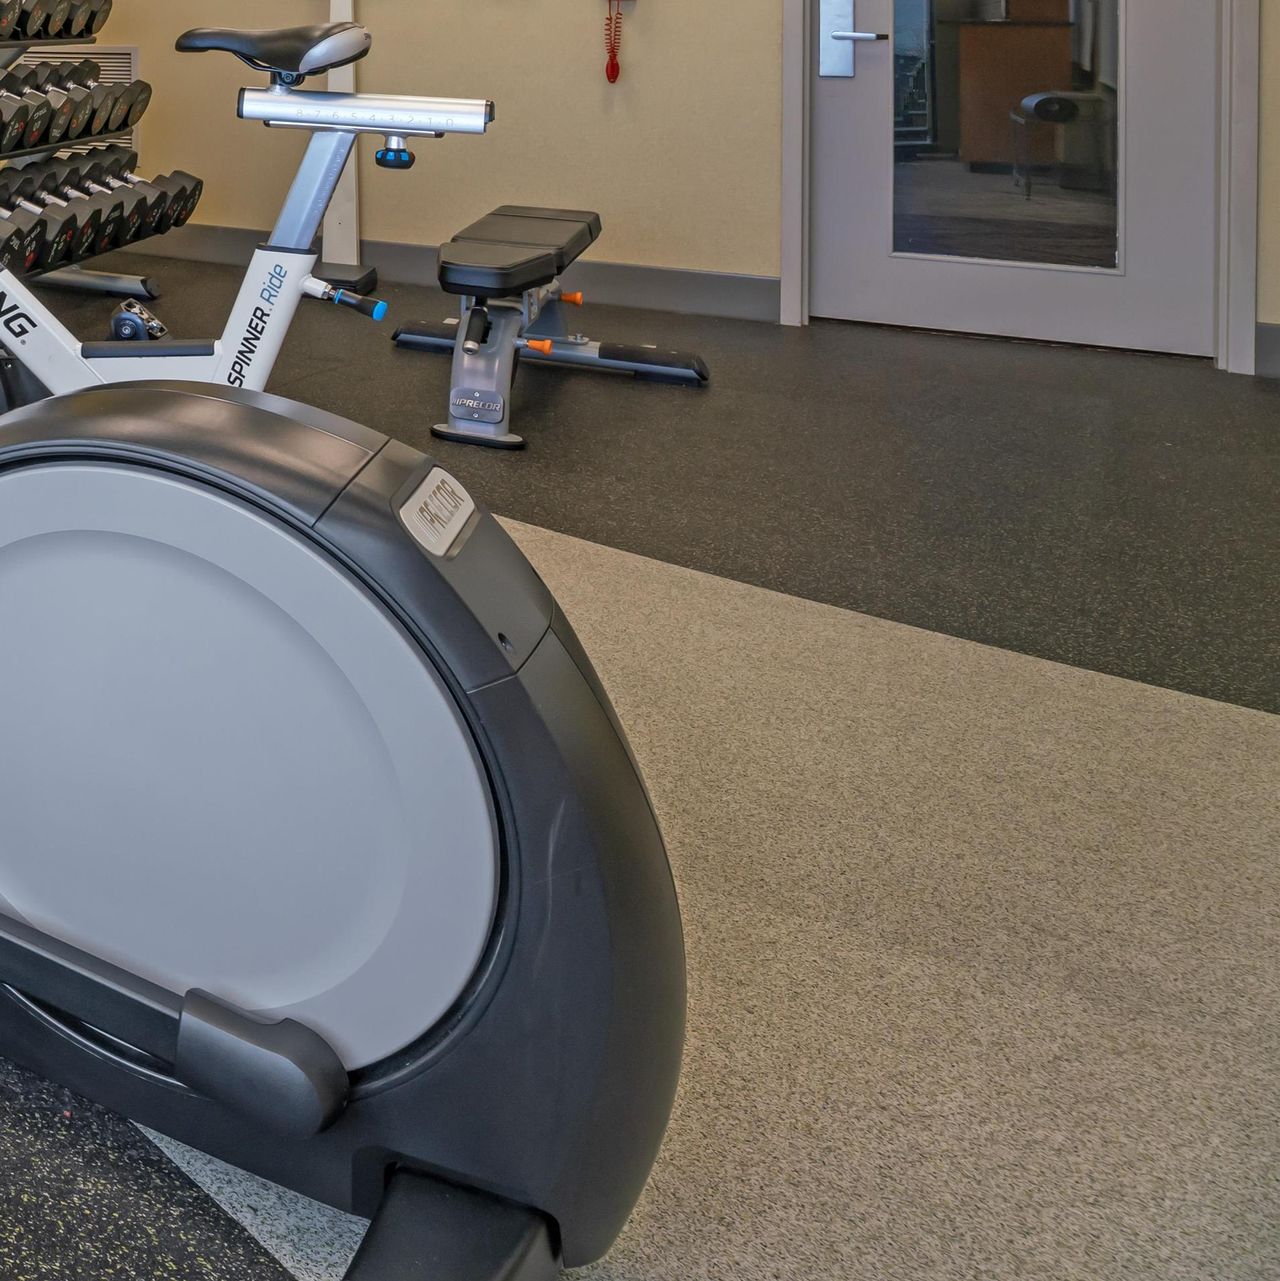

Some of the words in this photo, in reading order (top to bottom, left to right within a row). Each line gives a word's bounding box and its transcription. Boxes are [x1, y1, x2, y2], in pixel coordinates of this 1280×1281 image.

[227, 306, 270, 388] SPINNER
[260, 264, 288, 306] Ride
[458, 398, 500, 412] PRECOR
